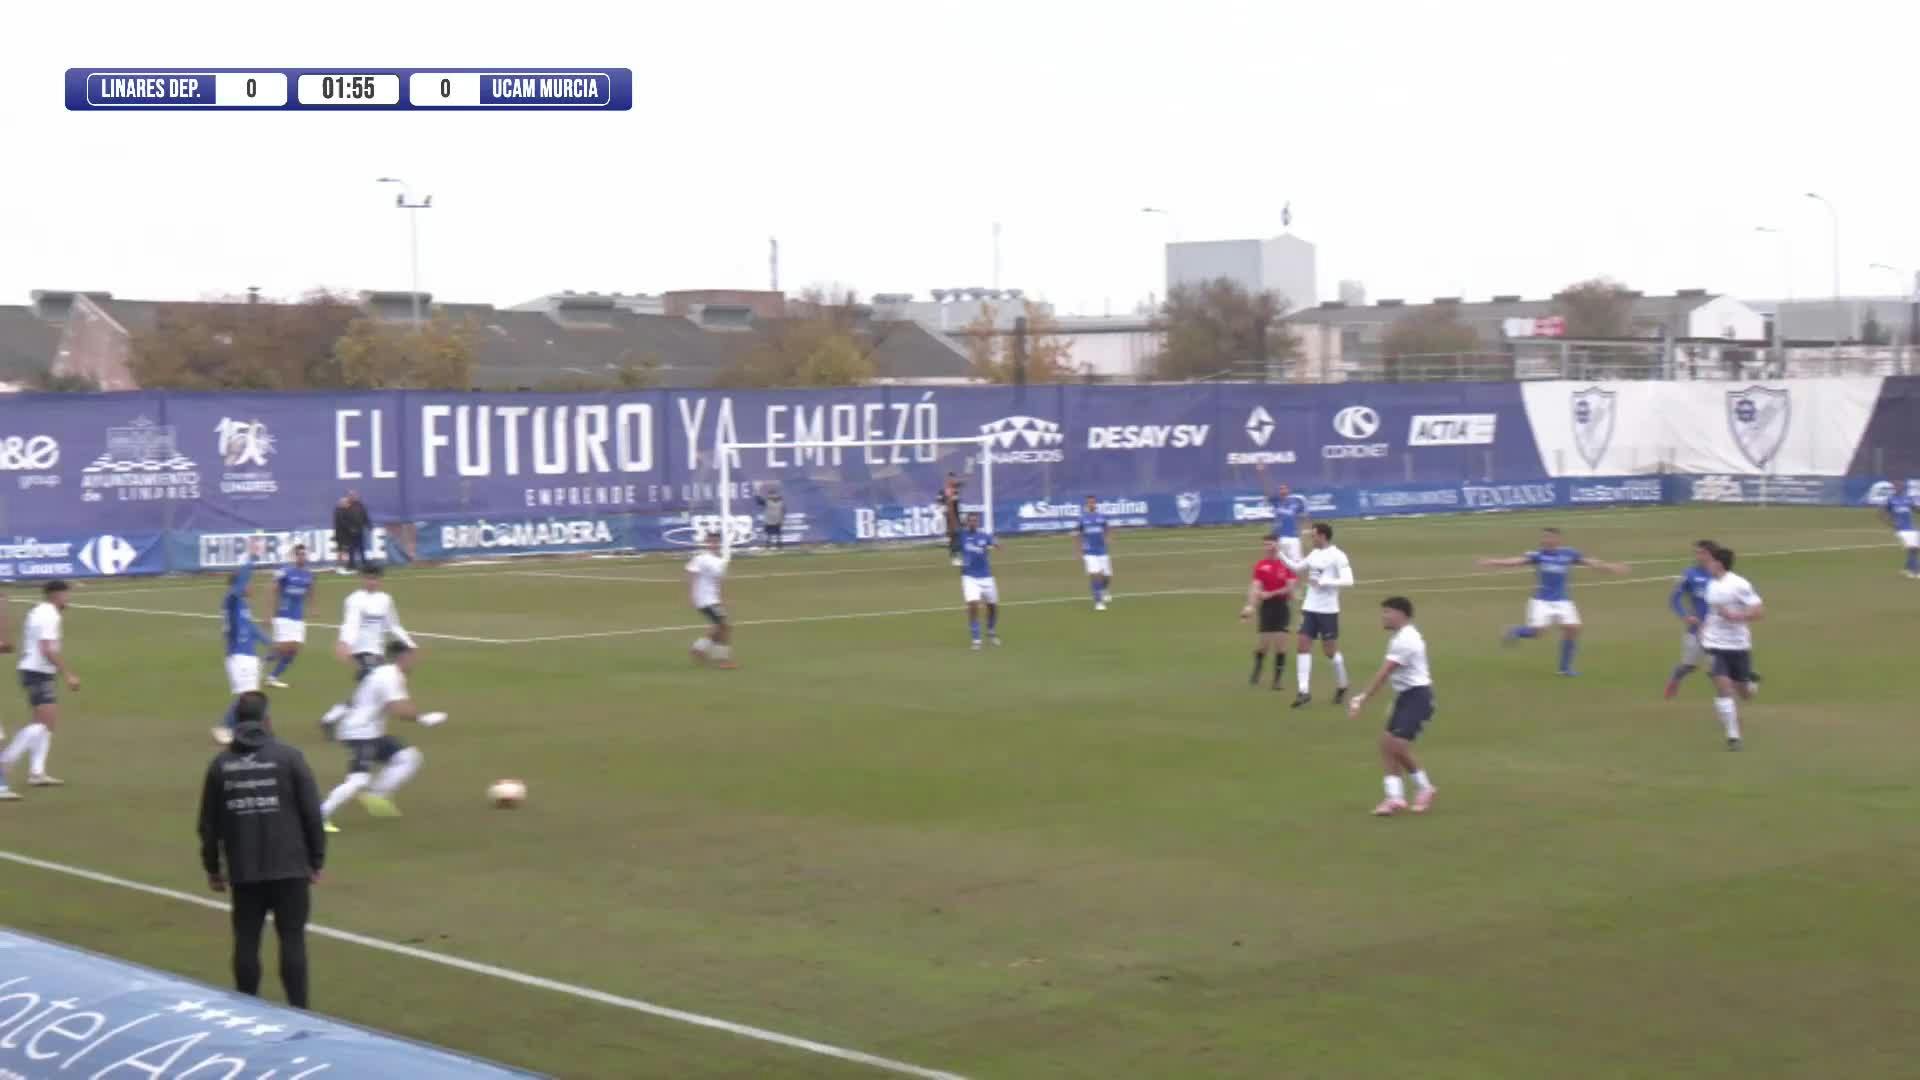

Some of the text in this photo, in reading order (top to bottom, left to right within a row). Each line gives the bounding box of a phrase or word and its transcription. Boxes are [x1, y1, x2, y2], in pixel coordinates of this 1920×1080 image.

[335, 391, 938, 479] EL FUTURO YA EMPEZÓ
[1087, 424, 1211, 450] DESAY SV
[1414, 420, 1469, 443] ACTIA
[525, 485, 635, 506] EMPRENDE
[1087, 498, 1149, 517] atalina
